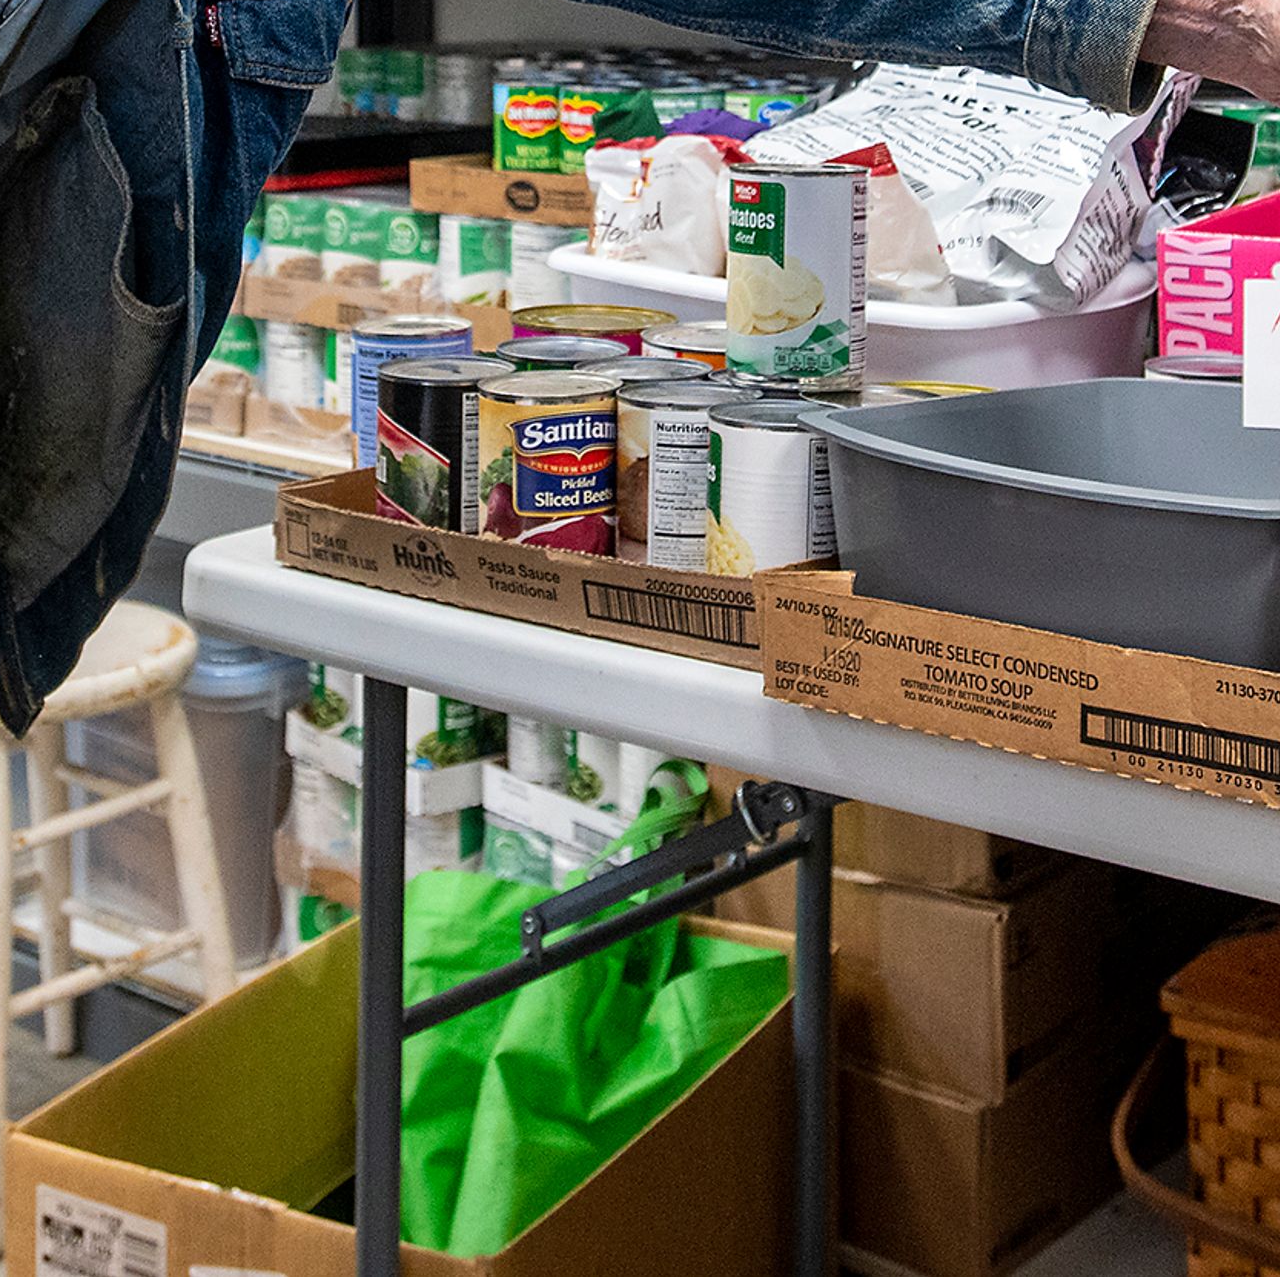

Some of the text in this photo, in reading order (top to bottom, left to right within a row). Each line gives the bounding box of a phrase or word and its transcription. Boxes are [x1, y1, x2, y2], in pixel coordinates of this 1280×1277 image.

[1164, 235, 1235, 357] PACK
[656, 422, 710, 434] Nutrition
[530, 460, 579, 474] PREMIUM
[561, 475, 597, 490] Pickled
[534, 488, 614, 508] Sliced Beets
[312, 547, 331, 561] NET
[331, 551, 345, 564] WT
[392, 543, 460, 580] Hunt's
[477, 556, 561, 585] Pasta Sauce
[486, 575, 558, 602] Traditional
[775, 596, 821, 616] 24/10.75
[775, 659, 860, 688] BEST IF USED BY:
[863, 628, 1100, 691] SIGNATURE SELECT CONDENSED
[775, 676, 829, 699] LOT CODE:
[924, 663, 1034, 701] TOMATO SOUP
[900, 677, 1058, 720] DISTRIBUTED BETTER LIVING BRANDS LLC
[918, 693, 933, 704] BOX
[995, 709, 1008, 721] CA
[1110, 751, 1117, 763] 1
[1128, 754, 1146, 769] 00
[1157, 759, 1204, 780] 21130
[1215, 771, 1263, 792] 37030
